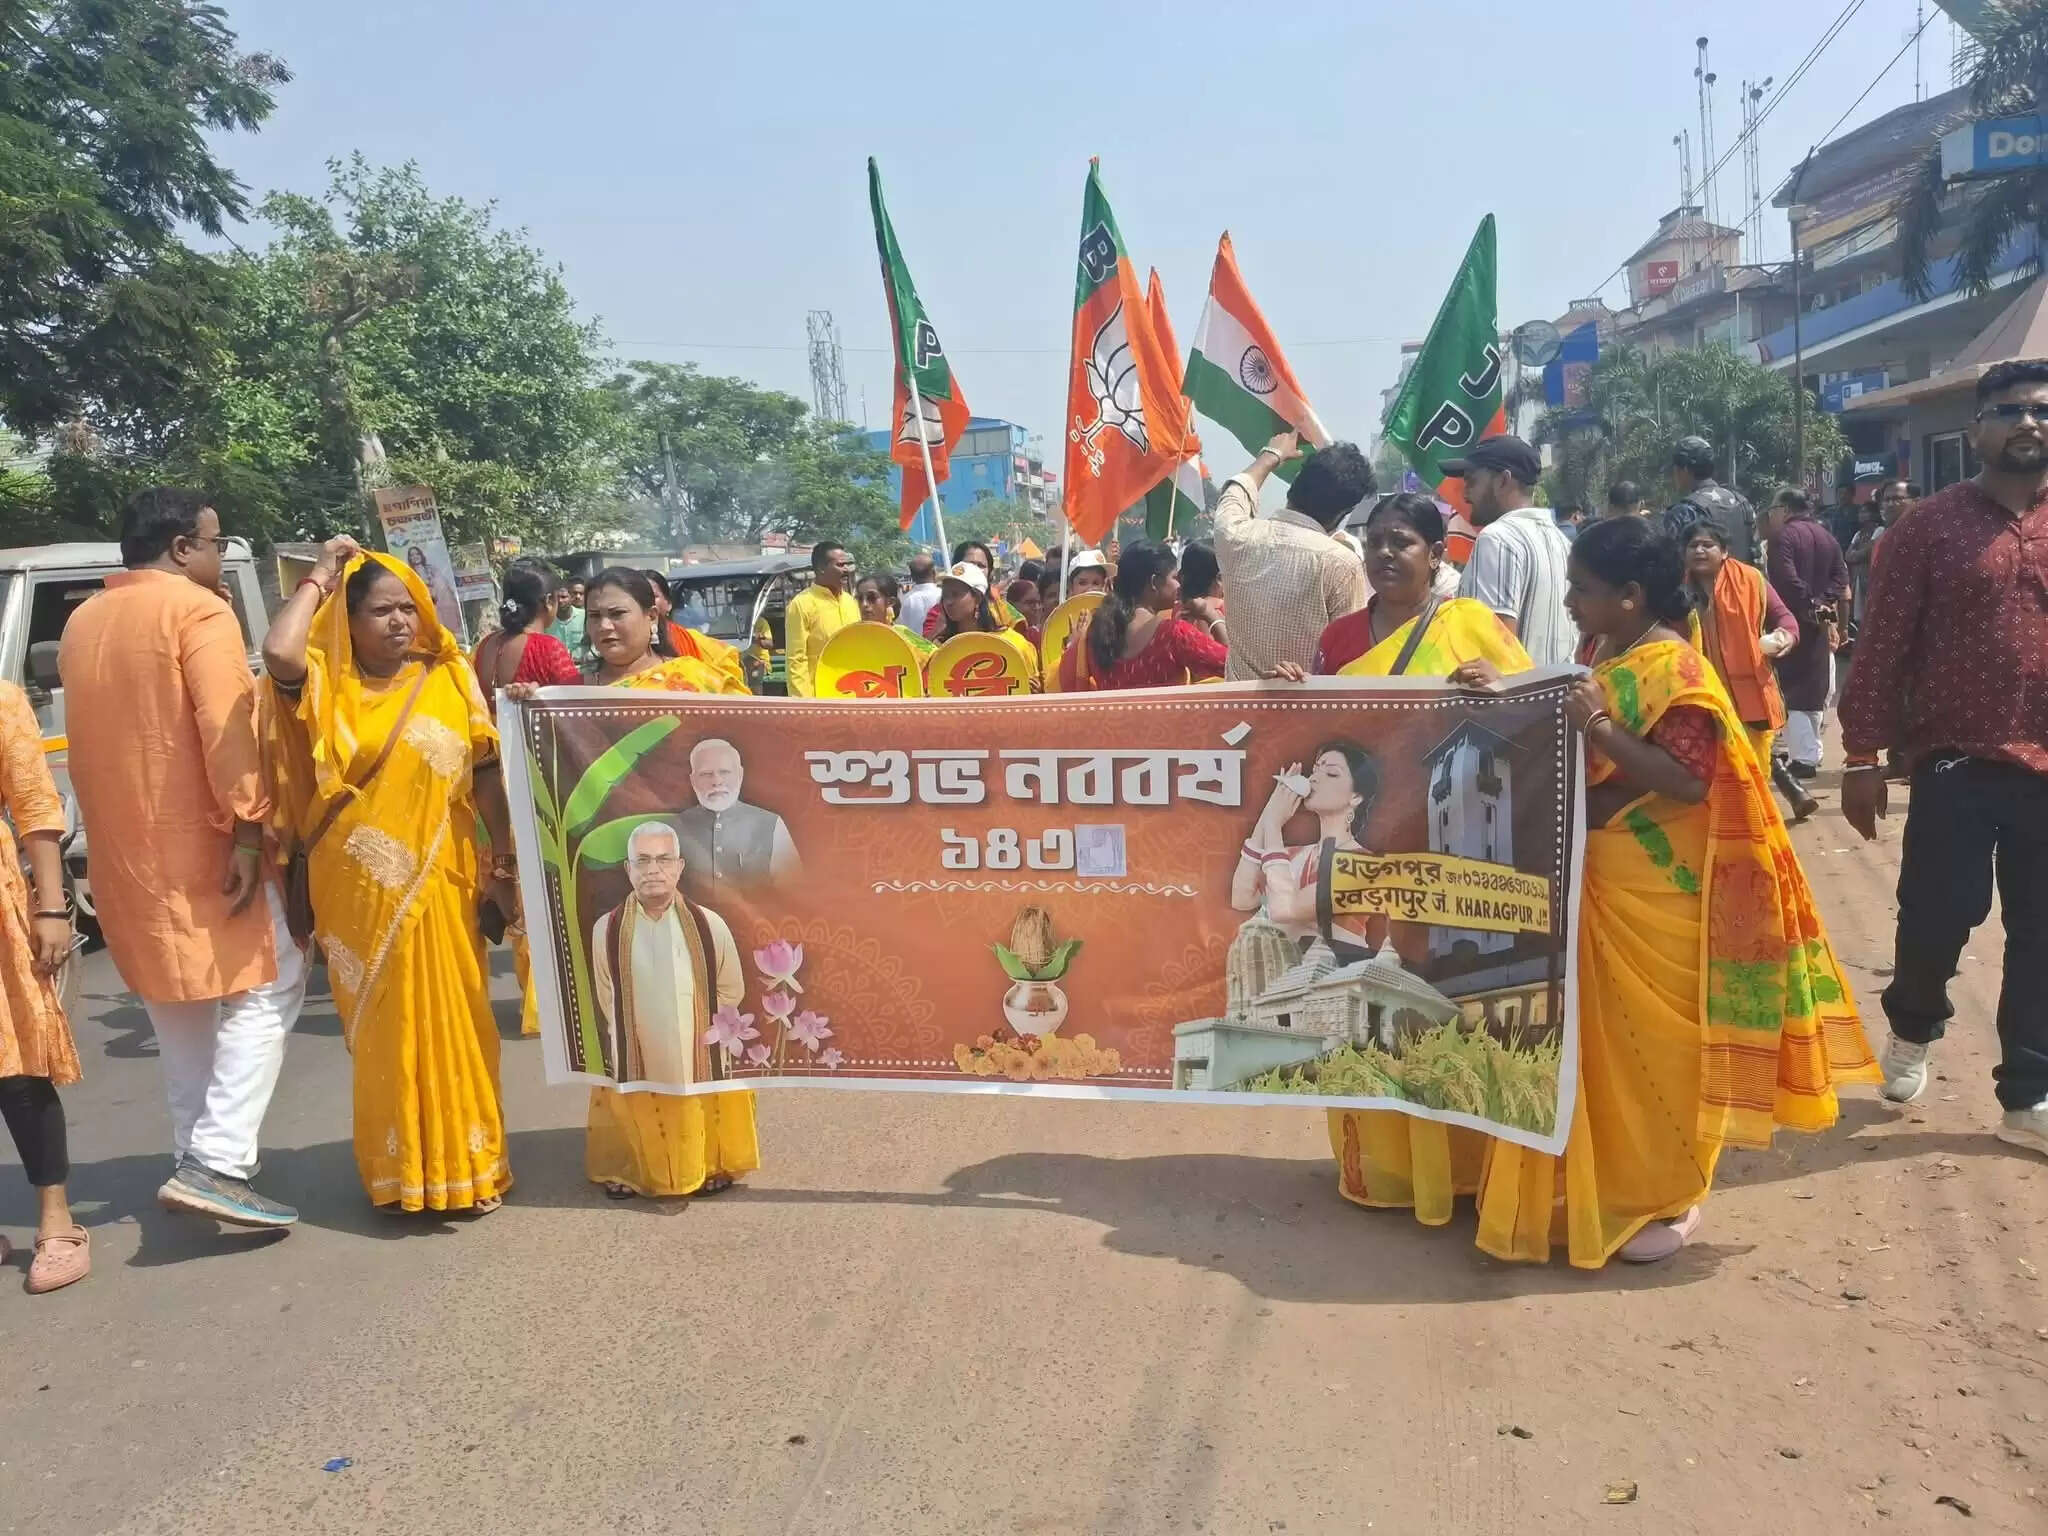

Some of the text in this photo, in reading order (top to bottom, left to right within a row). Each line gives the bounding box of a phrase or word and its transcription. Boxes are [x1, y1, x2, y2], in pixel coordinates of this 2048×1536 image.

[1989, 131, 2048, 157] Do
[804, 721, 1252, 806] শুভ নববর্ষ
[940, 828, 1075, 869] ১৪৩
[1455, 896, 1533, 923] KHARAGPUR
